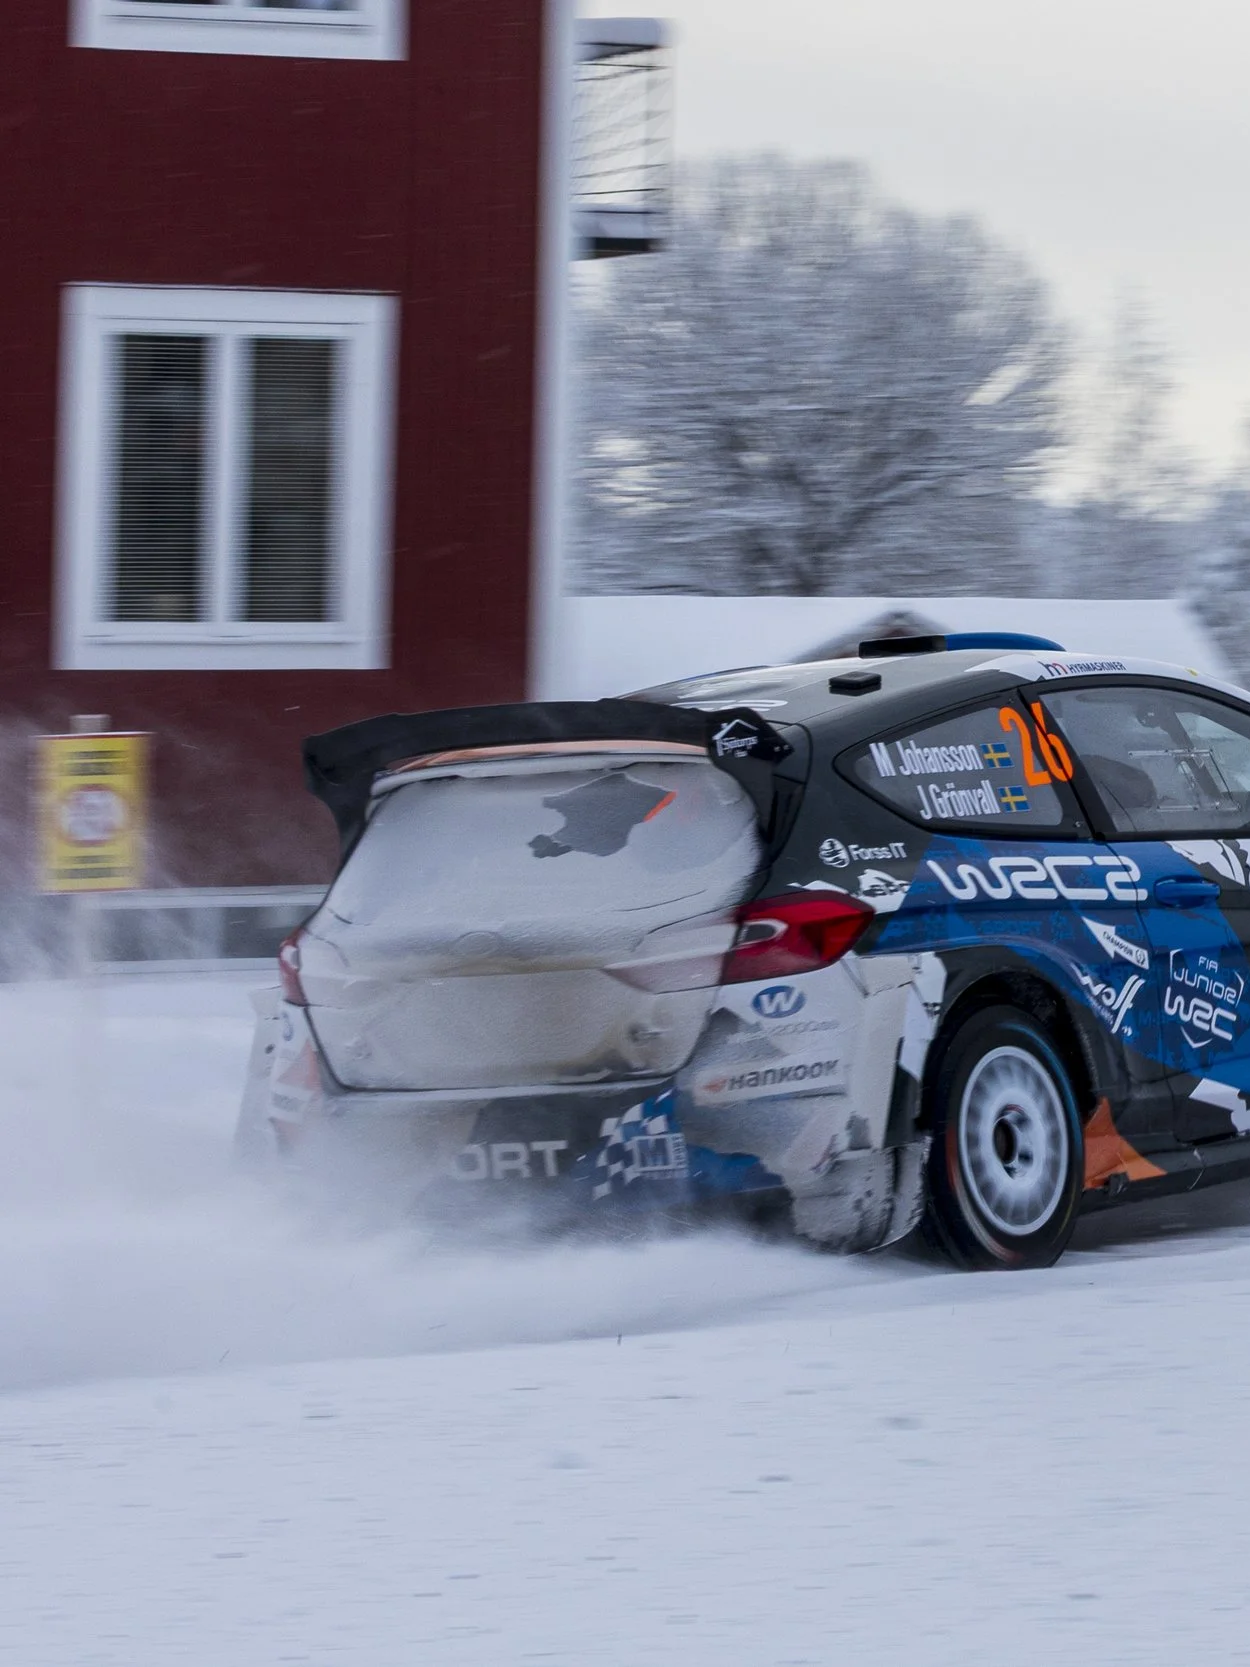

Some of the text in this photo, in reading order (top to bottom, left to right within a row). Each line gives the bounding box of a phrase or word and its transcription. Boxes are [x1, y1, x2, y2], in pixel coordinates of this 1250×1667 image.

[1069, 661, 1127, 674] HYRMASKINER
[869, 739, 984, 777] M Johansson
[999, 702, 1073, 787] 26
[917, 779, 1001, 820] J Grönvall
[926, 855, 1149, 901] WRC2
[1198, 955, 1219, 974] FIA
[1173, 967, 1238, 1005] JUNIOR
[1164, 985, 1237, 1041] WRC
